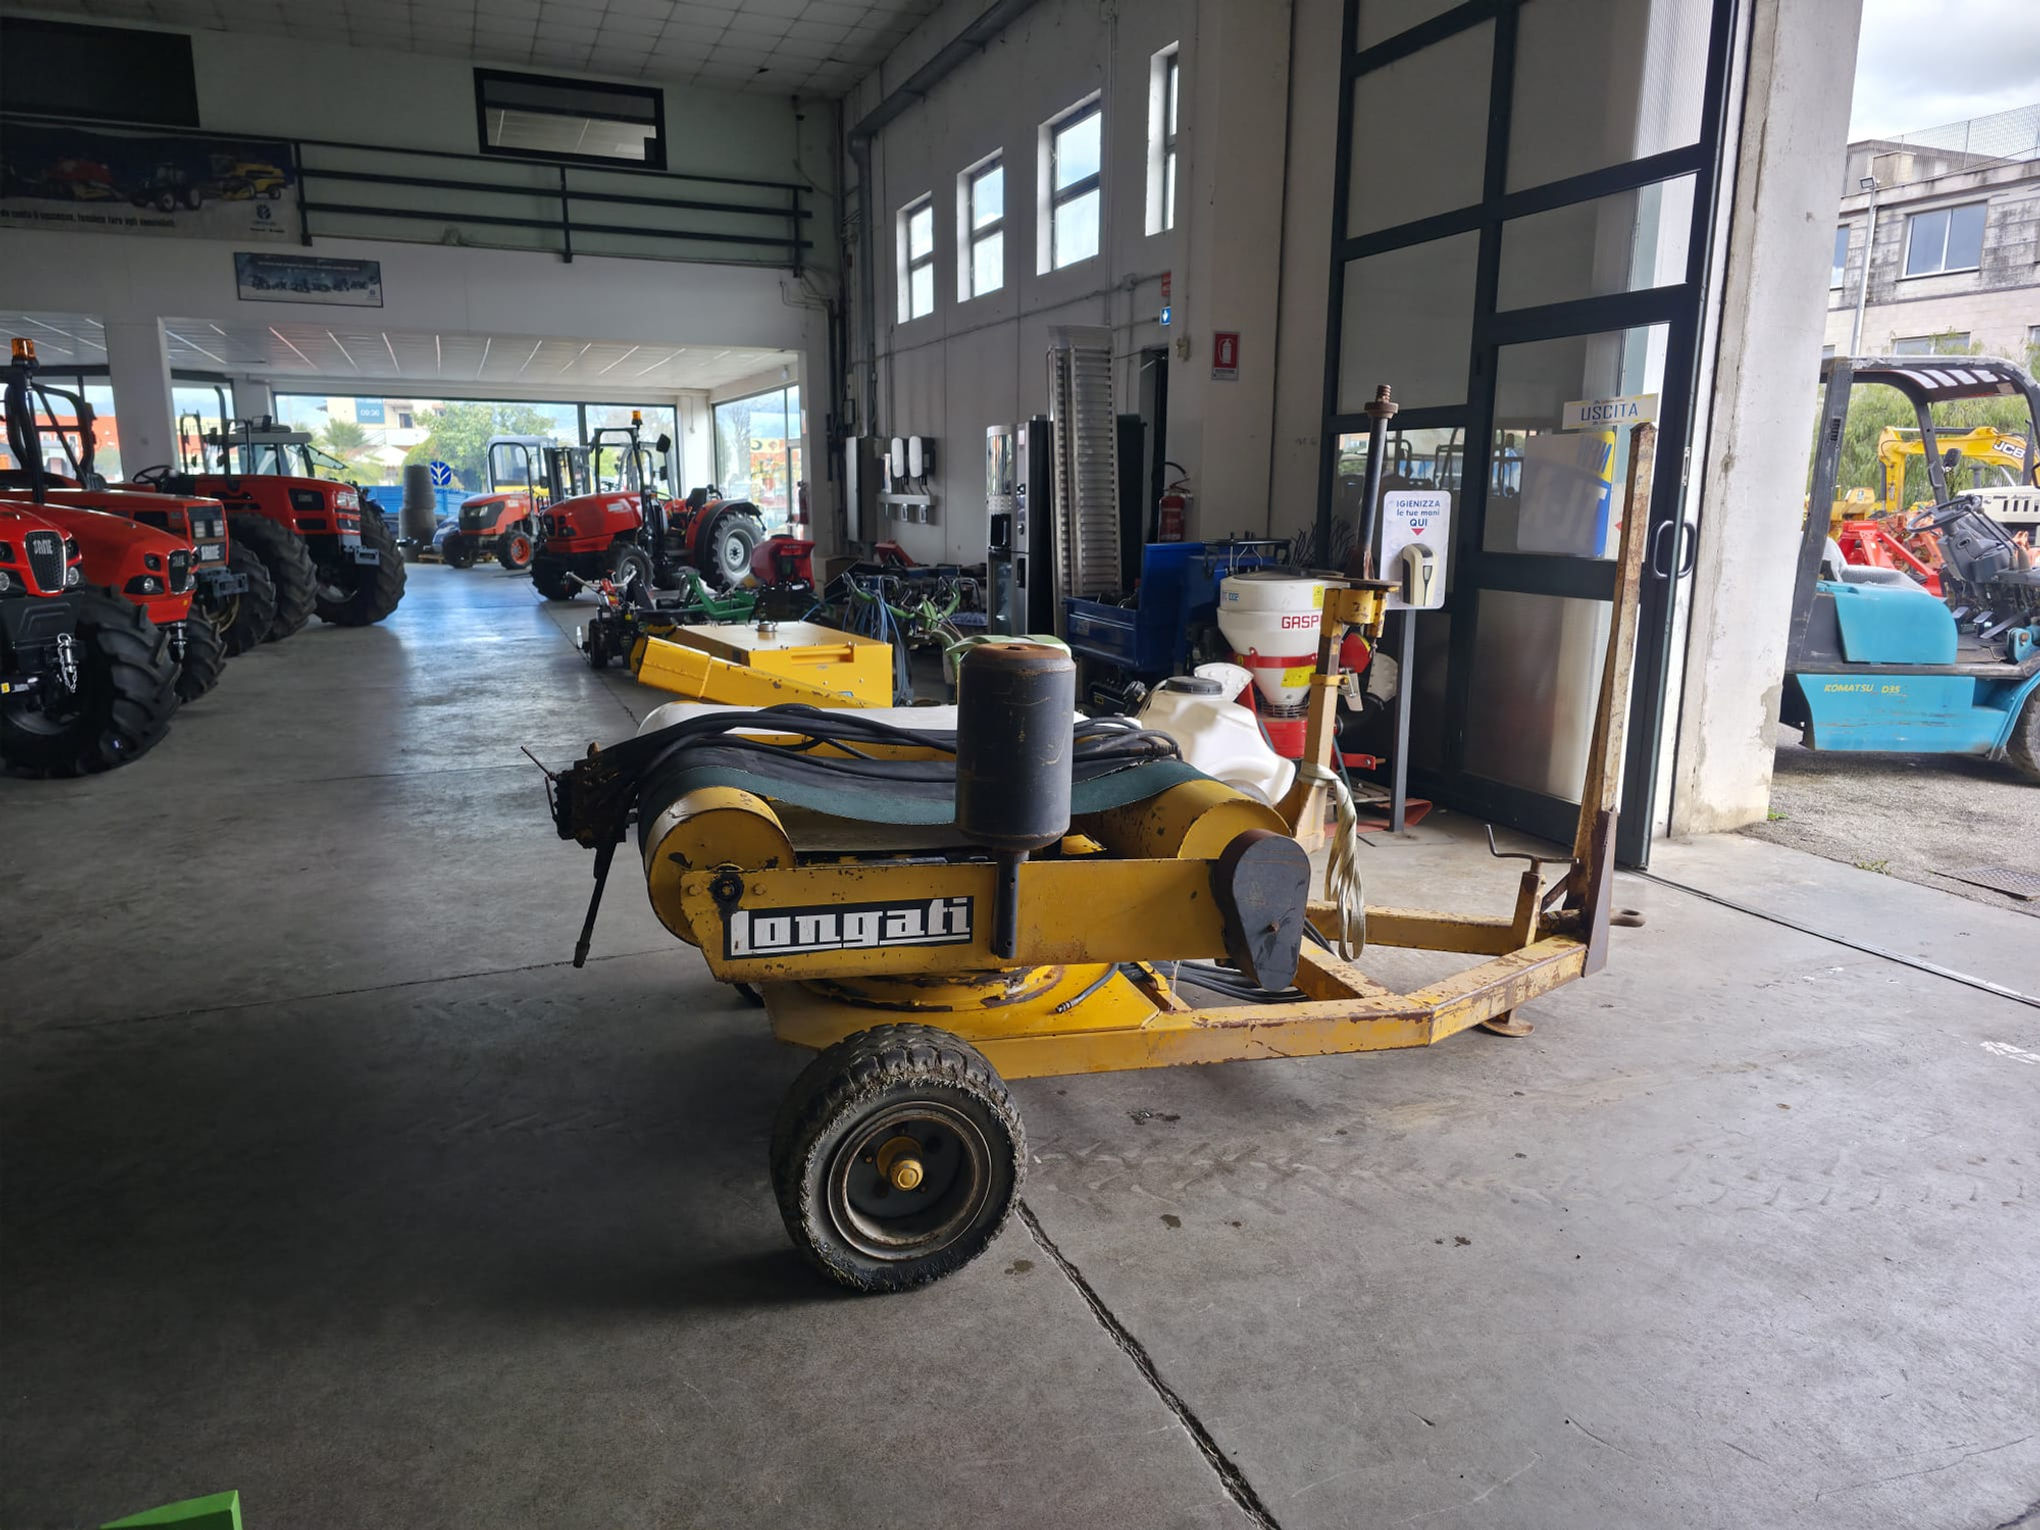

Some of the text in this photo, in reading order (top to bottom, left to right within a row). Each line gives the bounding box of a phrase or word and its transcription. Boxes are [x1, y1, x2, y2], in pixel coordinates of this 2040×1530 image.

[1581, 402, 1638, 421] USCITA
[1993, 441, 2026, 459] JCB
[1396, 500, 1441, 508] IGIENIZZA
[1409, 518, 1428, 527] QUI
[1281, 615, 1321, 629] GASP
[1823, 683, 1873, 693] KOMATSU
